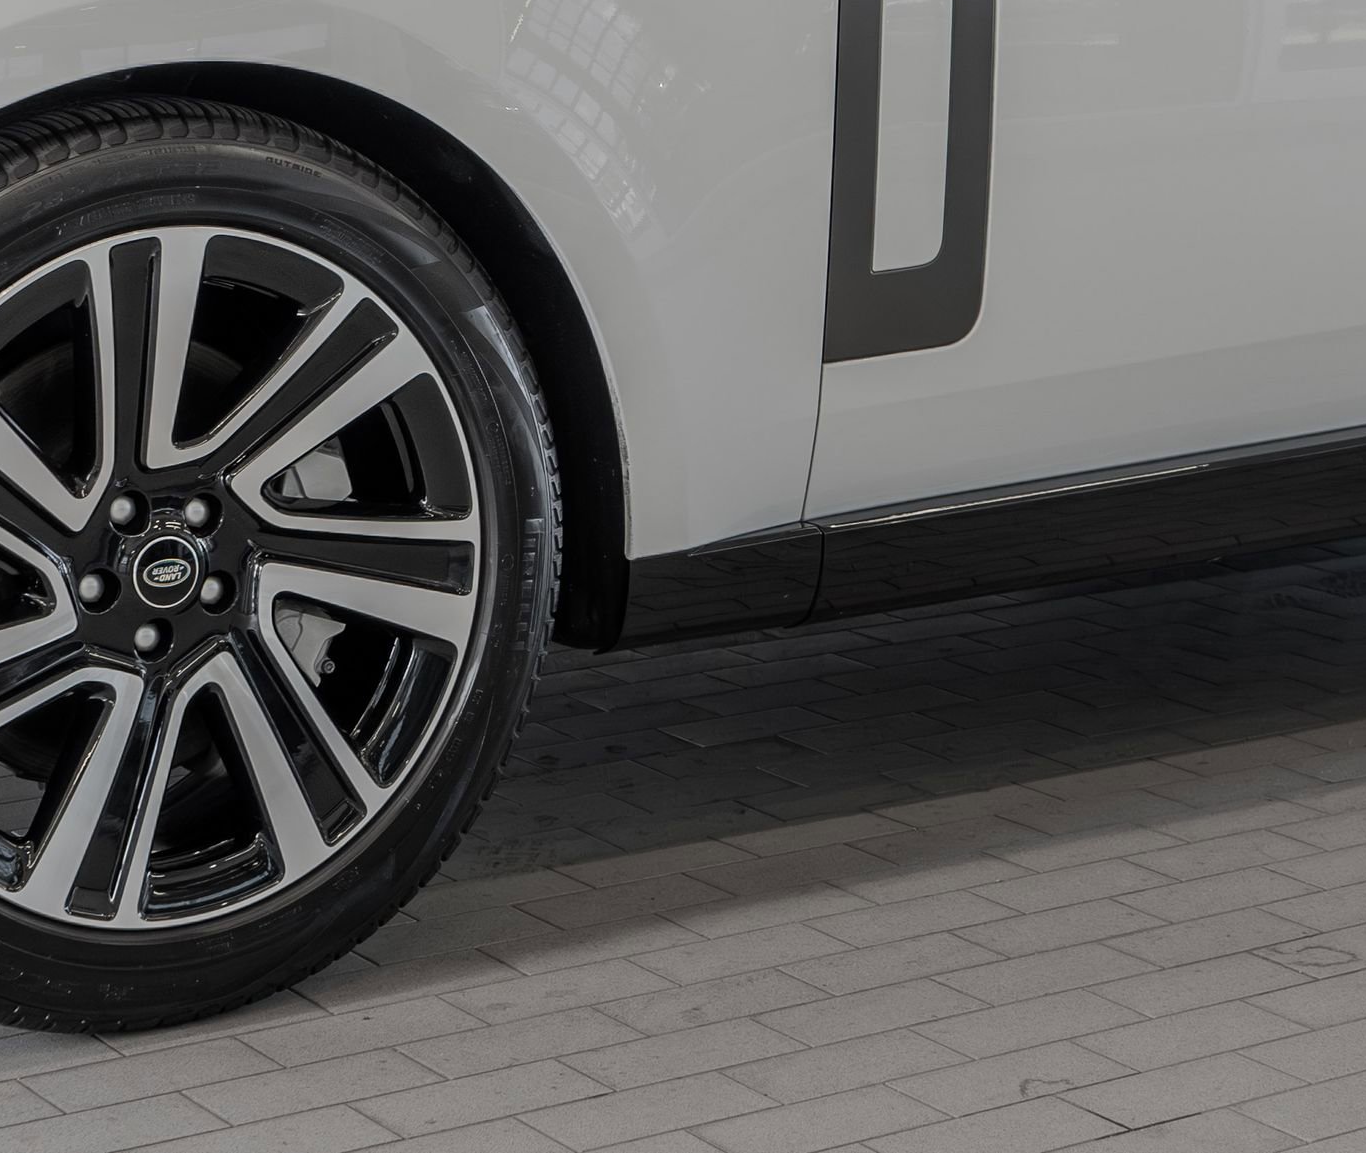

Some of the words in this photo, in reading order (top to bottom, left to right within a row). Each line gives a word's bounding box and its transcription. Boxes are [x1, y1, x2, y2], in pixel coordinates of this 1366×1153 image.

[265, 156, 323, 179] OUTSIDE
[152, 565, 180, 575] ROVER
[158, 572, 182, 582] LAND
